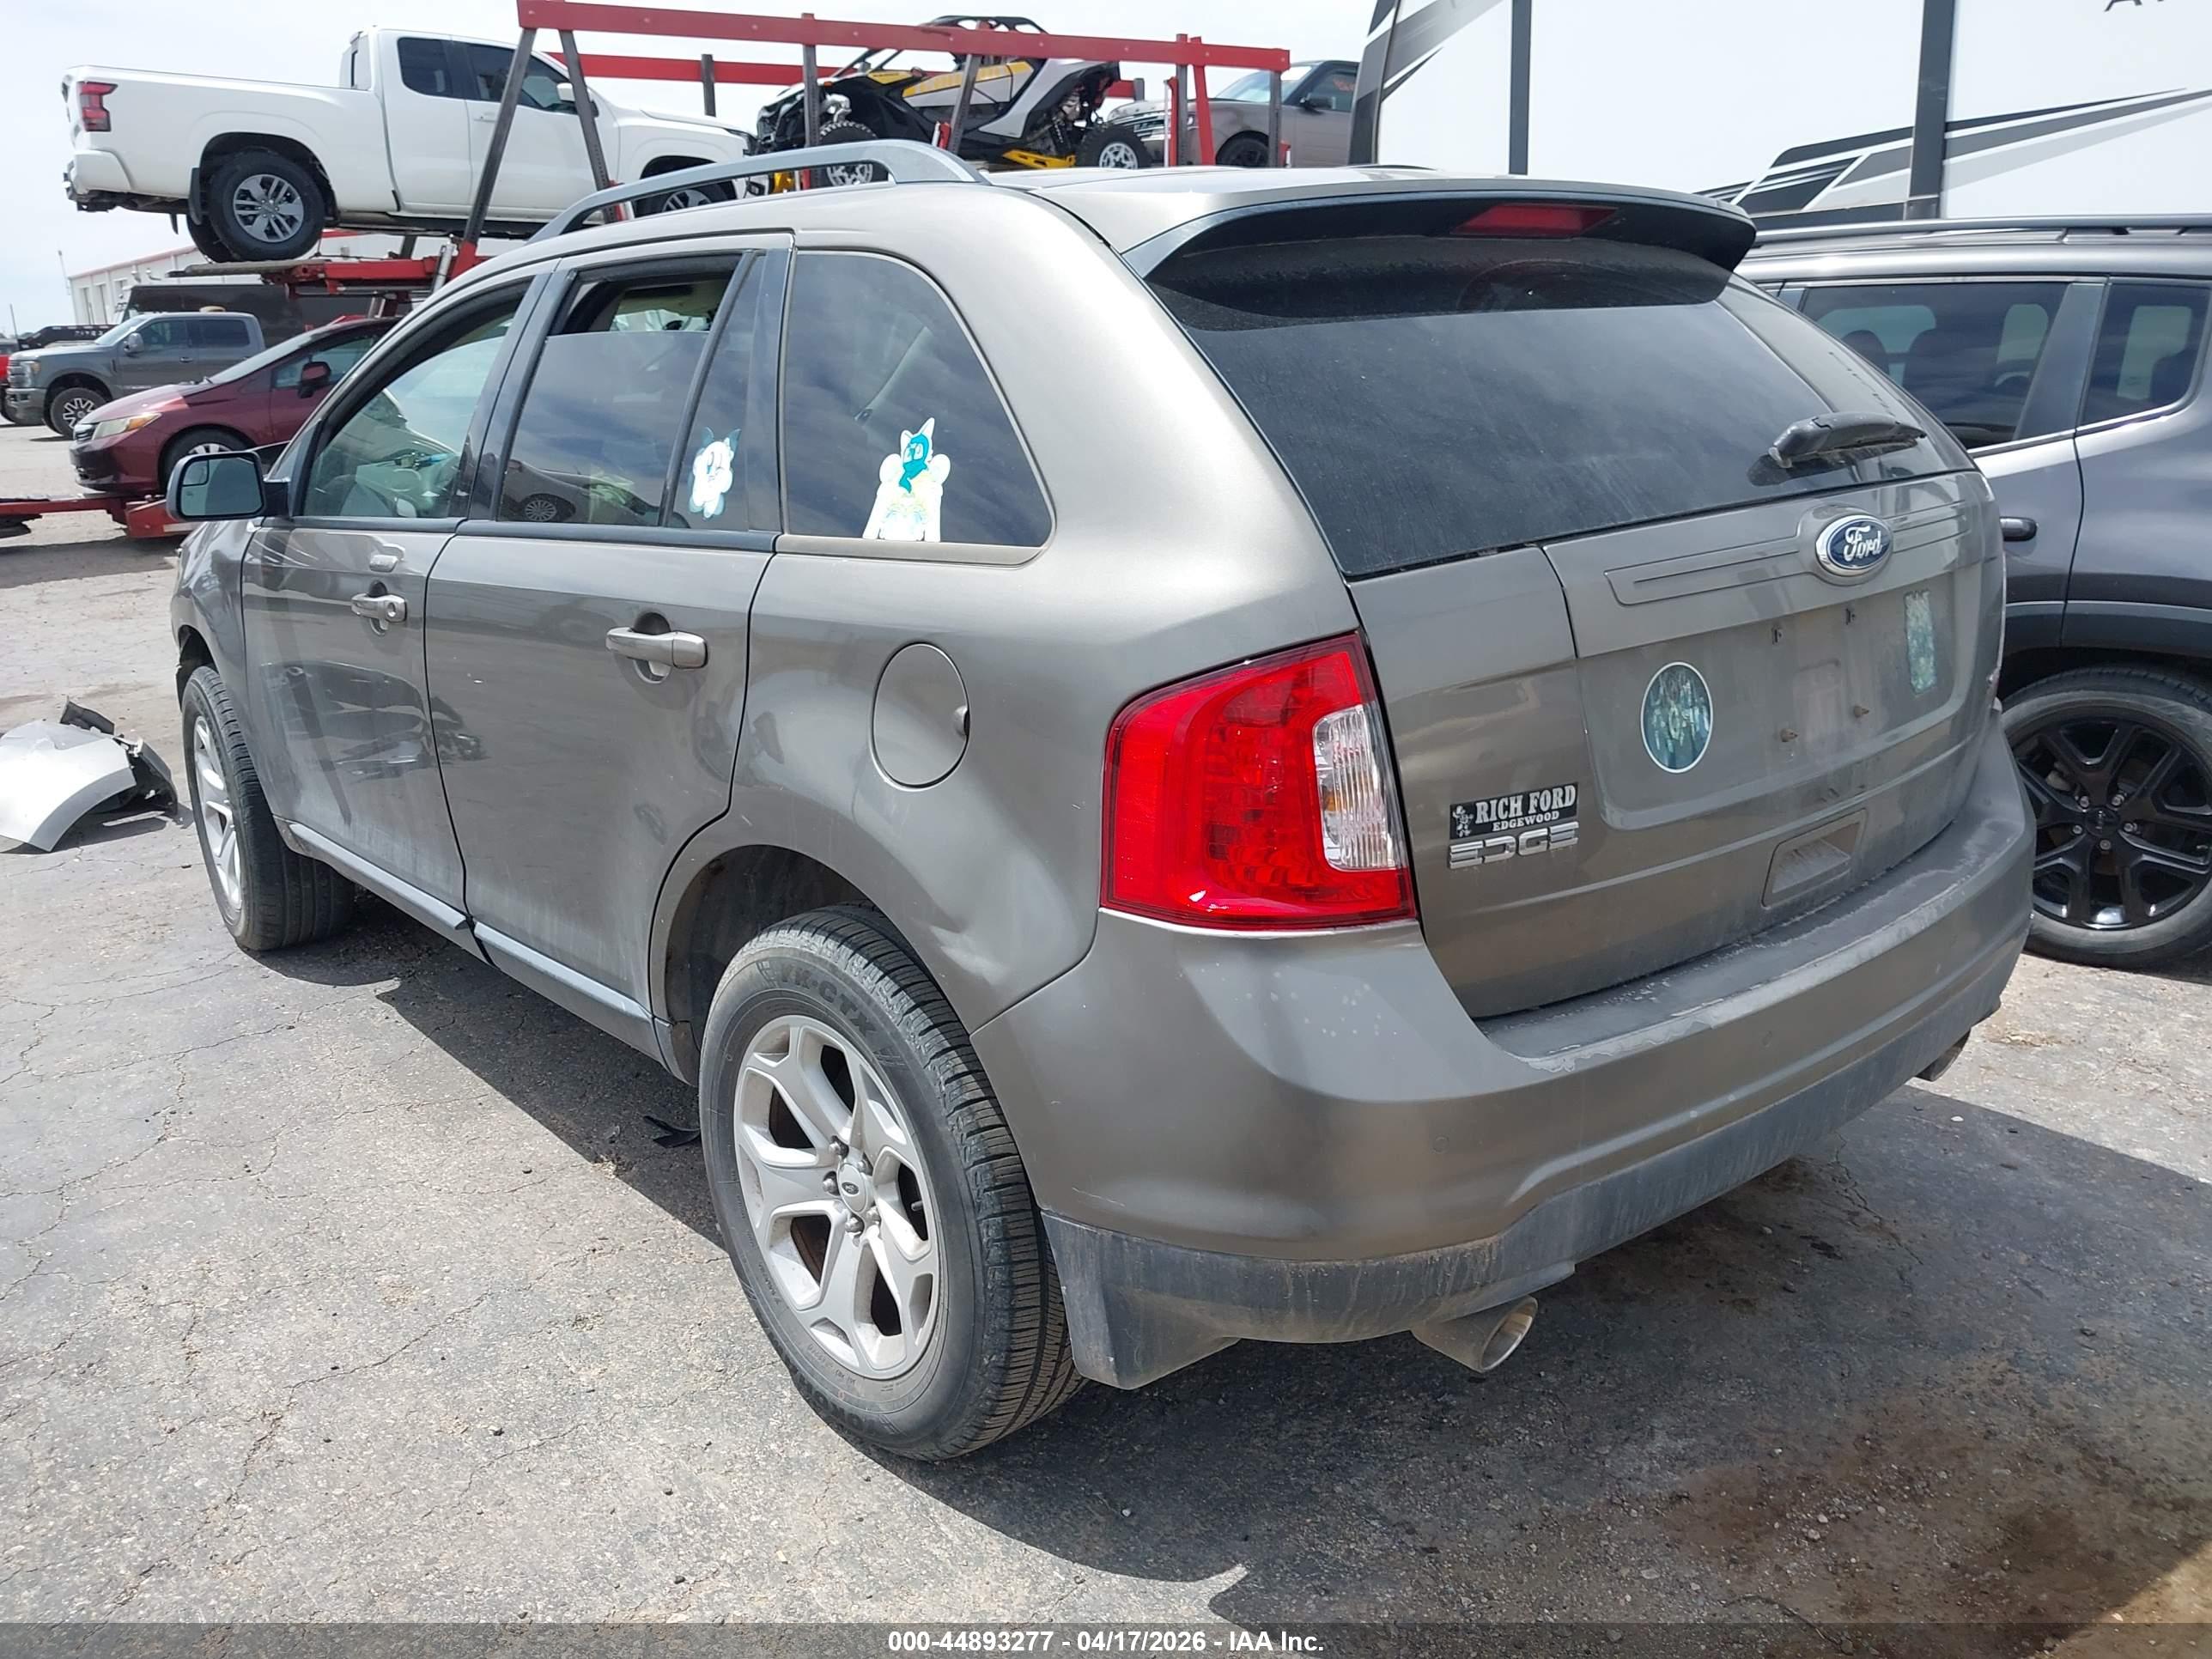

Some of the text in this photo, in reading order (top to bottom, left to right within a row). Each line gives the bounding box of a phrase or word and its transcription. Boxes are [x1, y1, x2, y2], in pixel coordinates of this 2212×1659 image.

[1844, 526, 1882, 562] Ford
[1474, 784, 1577, 824] RICH FORD
[1492, 810, 1560, 832] EDGEWOOD
[1449, 821, 1580, 870] EDGE
